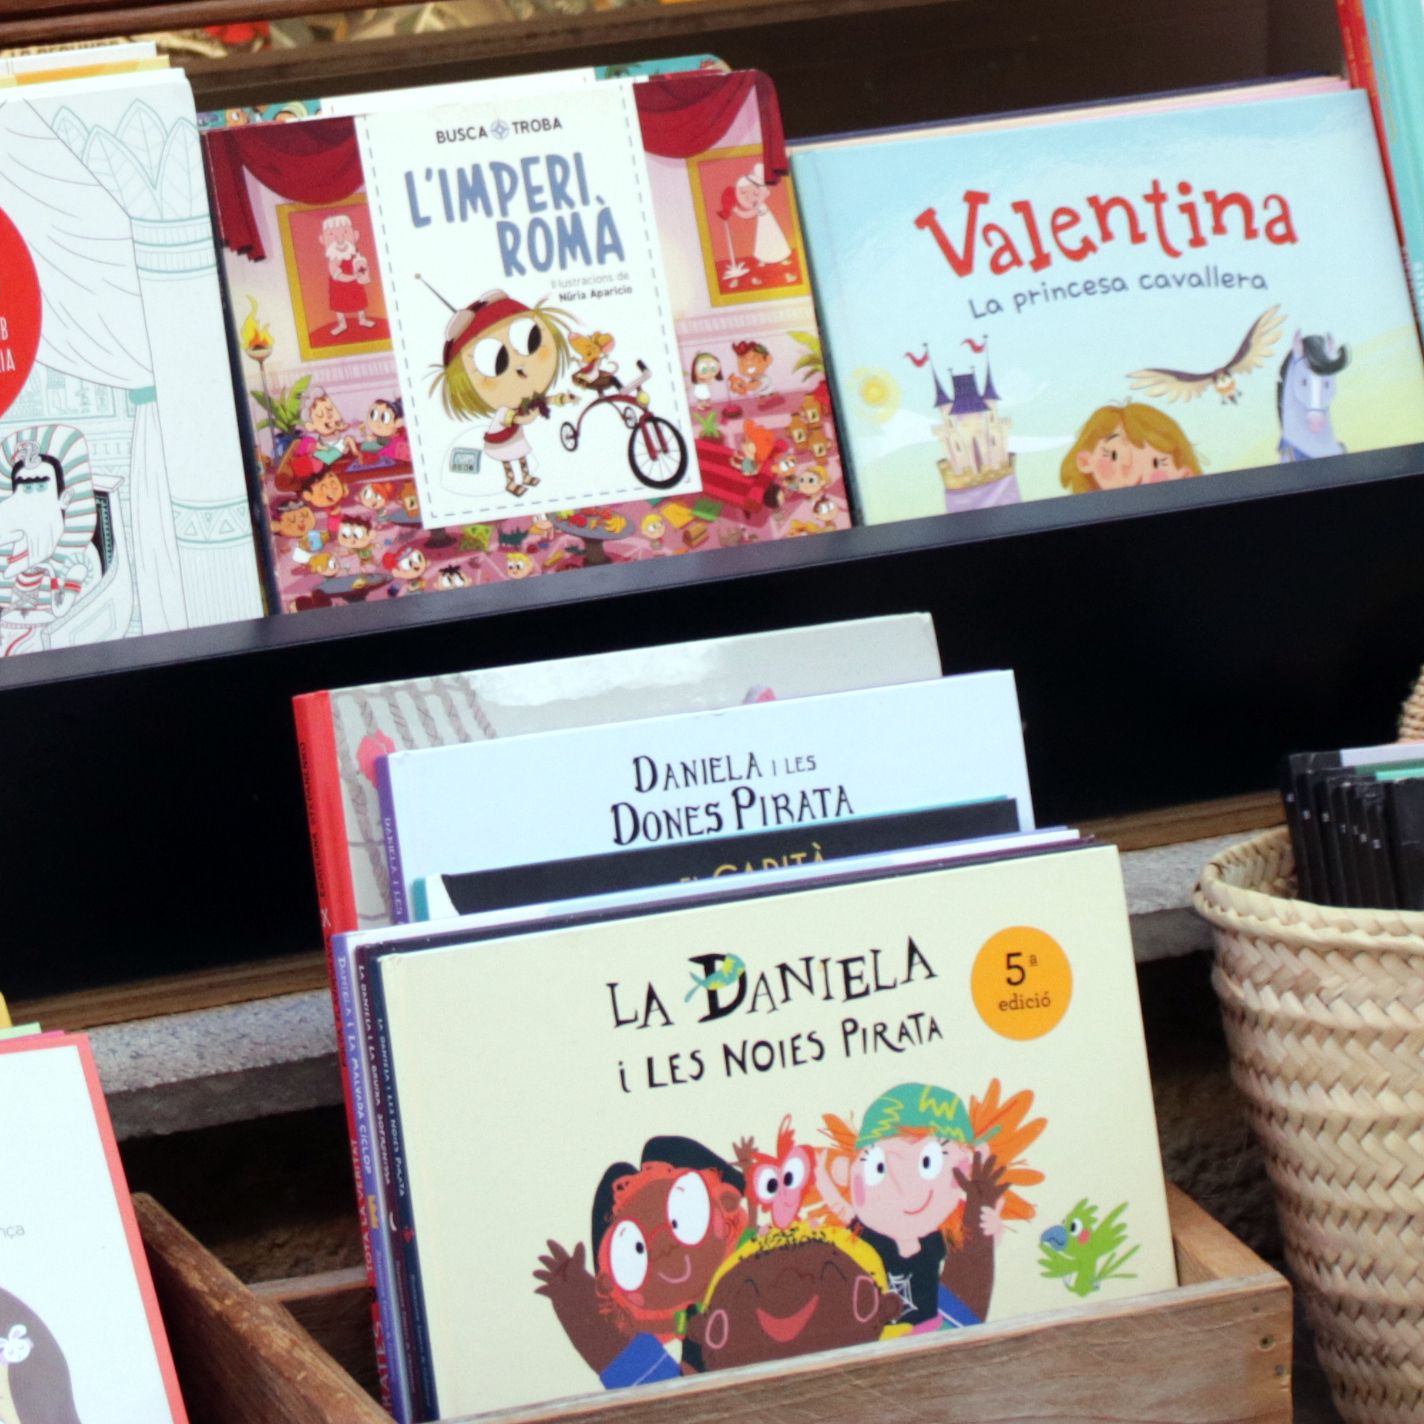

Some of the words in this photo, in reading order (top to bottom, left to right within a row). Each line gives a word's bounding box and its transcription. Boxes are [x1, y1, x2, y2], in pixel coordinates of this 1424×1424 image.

[436, 125, 488, 145] BUSCA
[512, 116, 563, 137] TROBA
[404, 153, 590, 228] L'IMPERI
[497, 195, 626, 278] ROMÀ
[914, 179, 1299, 278] Valentina
[558, 289, 589, 303] Núria
[590, 284, 633, 301] Aparicio
[970, 297, 1003, 320] La
[1013, 274, 1129, 313] princesa
[1140, 265, 1268, 292] cavallera
[632, 752, 763, 793] DANIELA
[783, 752, 817, 774] LES
[611, 797, 725, 846] DONES
[732, 784, 855, 830] PIRATA
[607, 979, 674, 1029] LA
[689, 936, 938, 1024] DANIELA
[998, 991, 1052, 1013] edició
[646, 1049, 706, 1089] LES
[723, 1032, 827, 1076] NOIES
[838, 1013, 944, 1056] PIRATA
